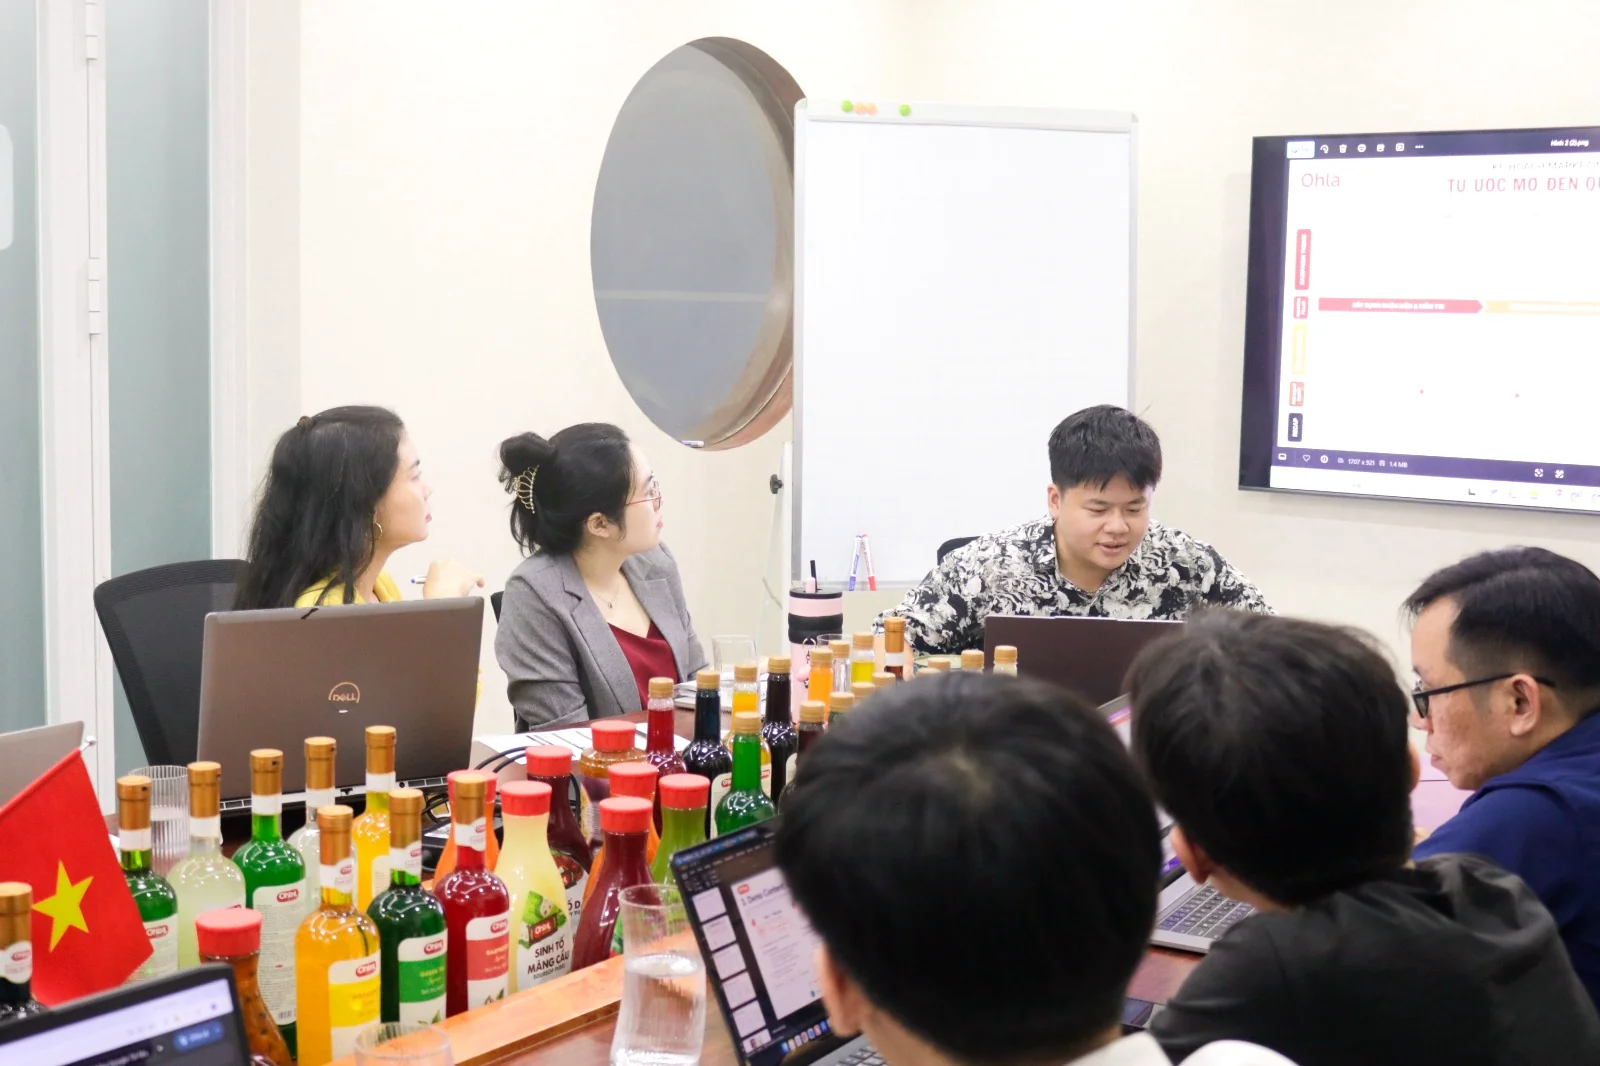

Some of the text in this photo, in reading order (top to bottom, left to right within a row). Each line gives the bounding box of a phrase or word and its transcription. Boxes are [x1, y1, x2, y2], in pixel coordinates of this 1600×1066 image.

[1301, 173, 1340, 188] Ohla
[332, 692, 357, 702] DELL
[534, 934, 564, 958] SINH TỐ
